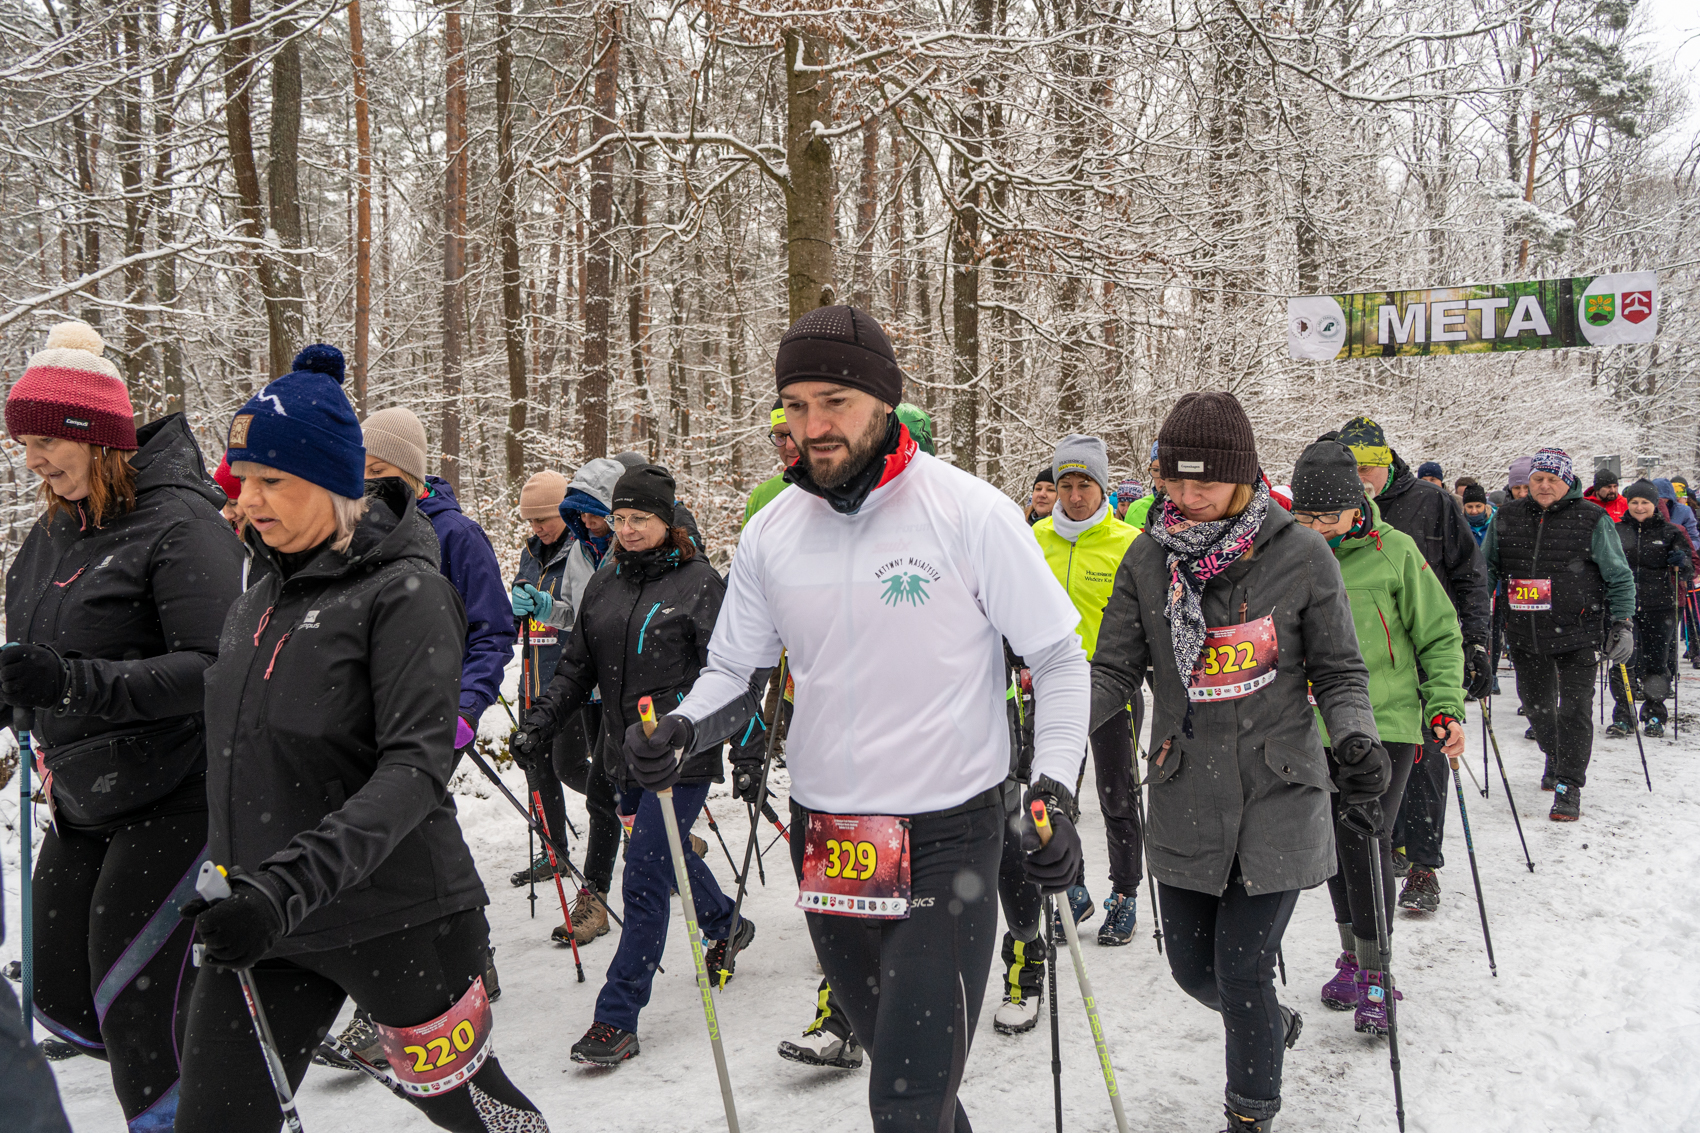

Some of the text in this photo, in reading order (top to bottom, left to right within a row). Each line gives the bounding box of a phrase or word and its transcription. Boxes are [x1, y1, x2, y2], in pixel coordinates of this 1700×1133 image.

[1378, 295, 1552, 345] META
[874, 558, 903, 579] AKTYWNY
[1515, 586, 1540, 600] 214
[1202, 640, 1258, 675] 322
[91, 771, 119, 793] 4F
[824, 838, 878, 881] 329
[910, 896, 936, 909] SICS
[686, 919, 720, 1041] FLASH CARBON
[402, 1018, 476, 1074] 220
[1083, 996, 1119, 1097] FLASH CARBON
